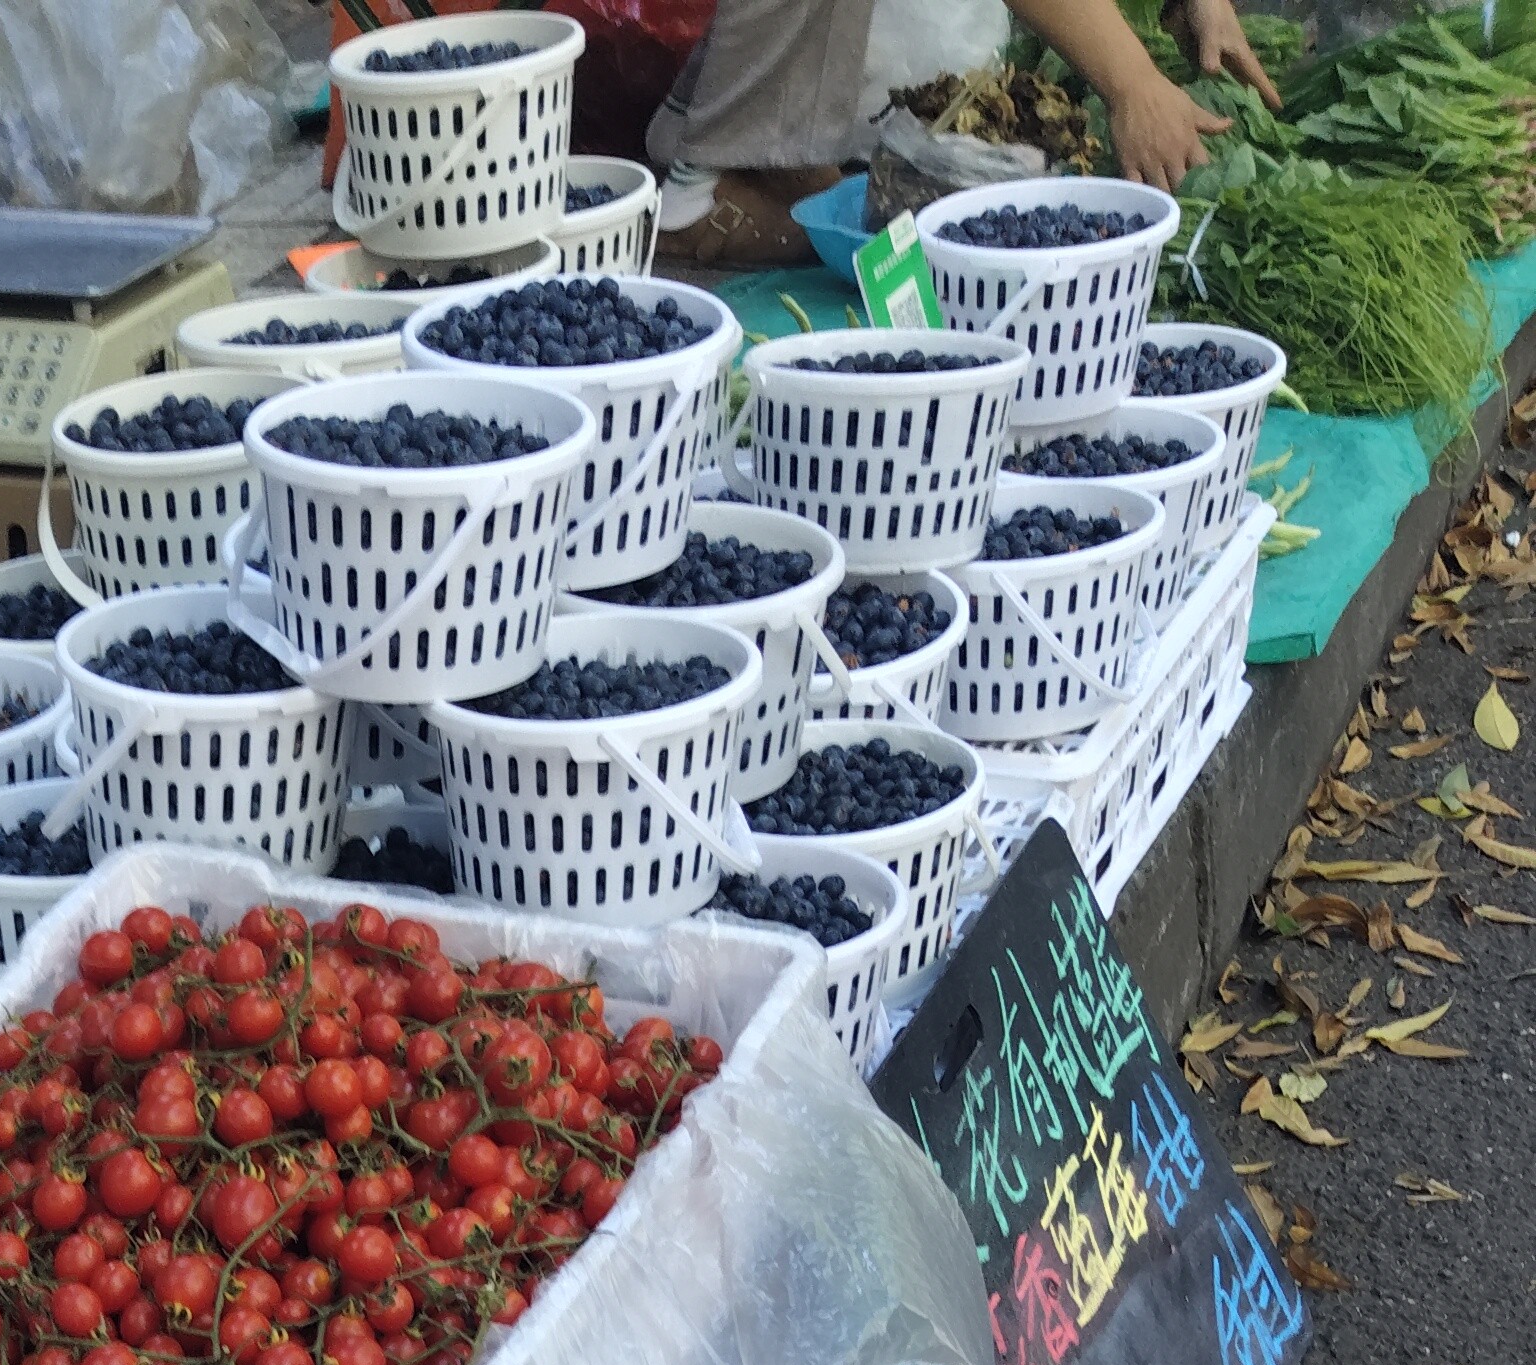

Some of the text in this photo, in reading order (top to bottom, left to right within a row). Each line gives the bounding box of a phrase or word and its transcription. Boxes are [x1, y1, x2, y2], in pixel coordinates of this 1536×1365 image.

[911, 875, 1161, 1263] 花有机蓝莓
